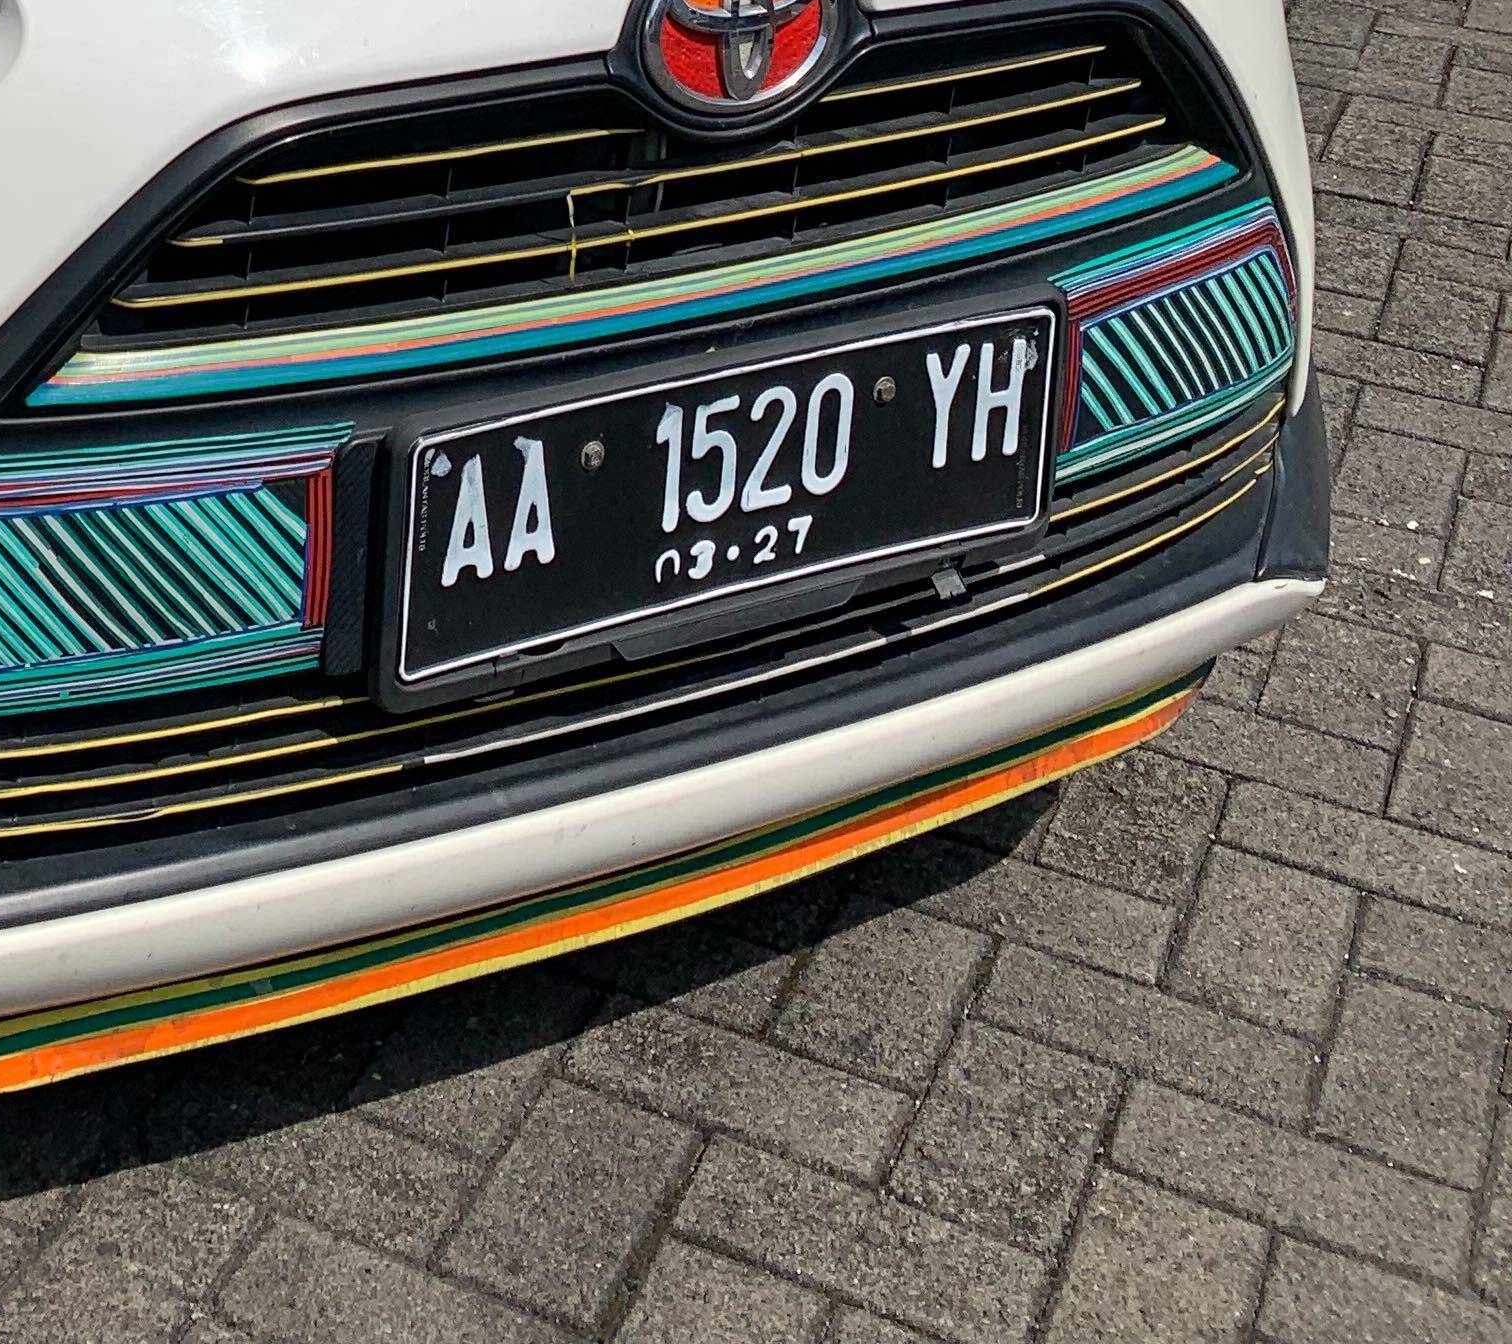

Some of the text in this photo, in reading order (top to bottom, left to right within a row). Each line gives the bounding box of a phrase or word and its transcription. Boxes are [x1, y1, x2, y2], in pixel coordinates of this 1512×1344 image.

[440, 435, 556, 588] AA
[655, 372, 855, 533] 1520
[926, 338, 1030, 470] YH
